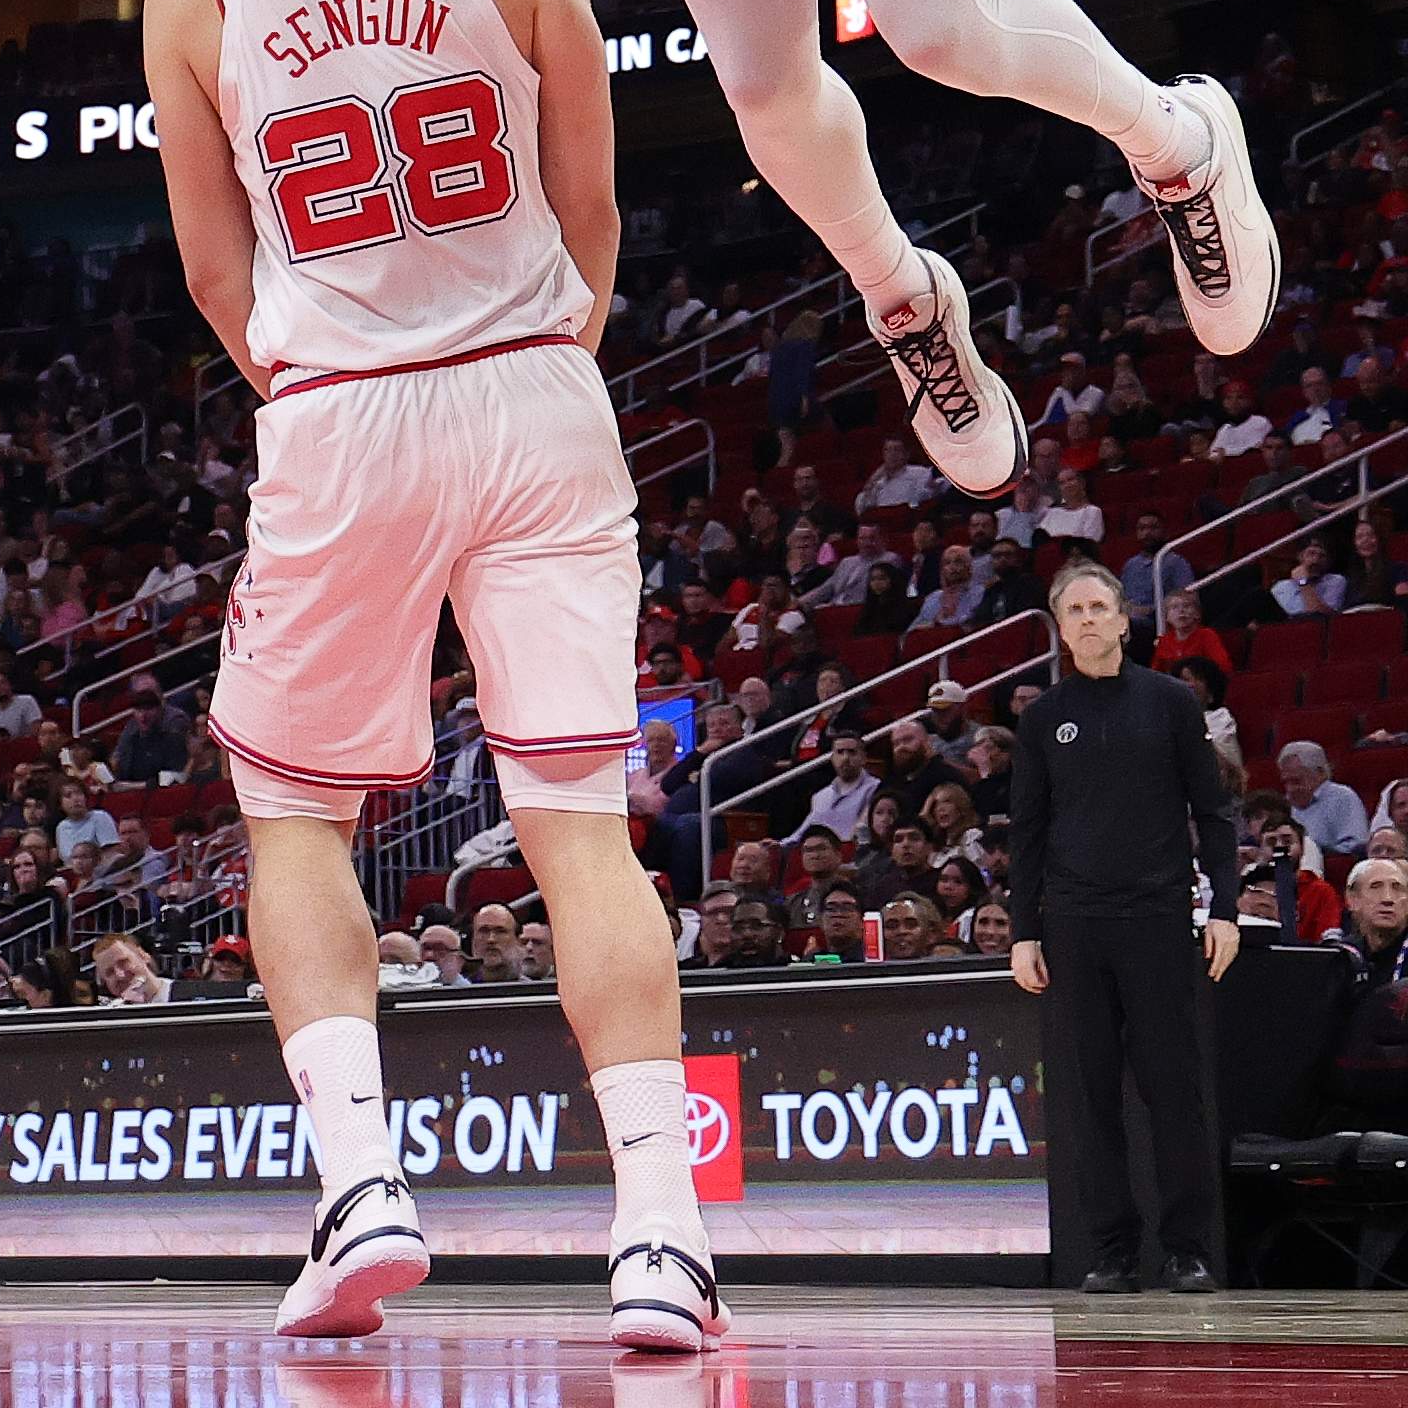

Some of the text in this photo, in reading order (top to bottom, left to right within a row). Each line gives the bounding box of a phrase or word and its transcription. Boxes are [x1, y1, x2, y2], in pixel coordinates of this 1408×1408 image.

[605, 33, 652, 73] IN
[80, 102, 159, 154] PIC
[256, 69, 519, 262] 28
[9, 1109, 173, 1184] SALES
[183, 1104, 324, 1180] EVEN
[390, 1096, 442, 1175] IS
[455, 1093, 559, 1174] ON
[762, 1088, 1029, 1161] TOYOTA
